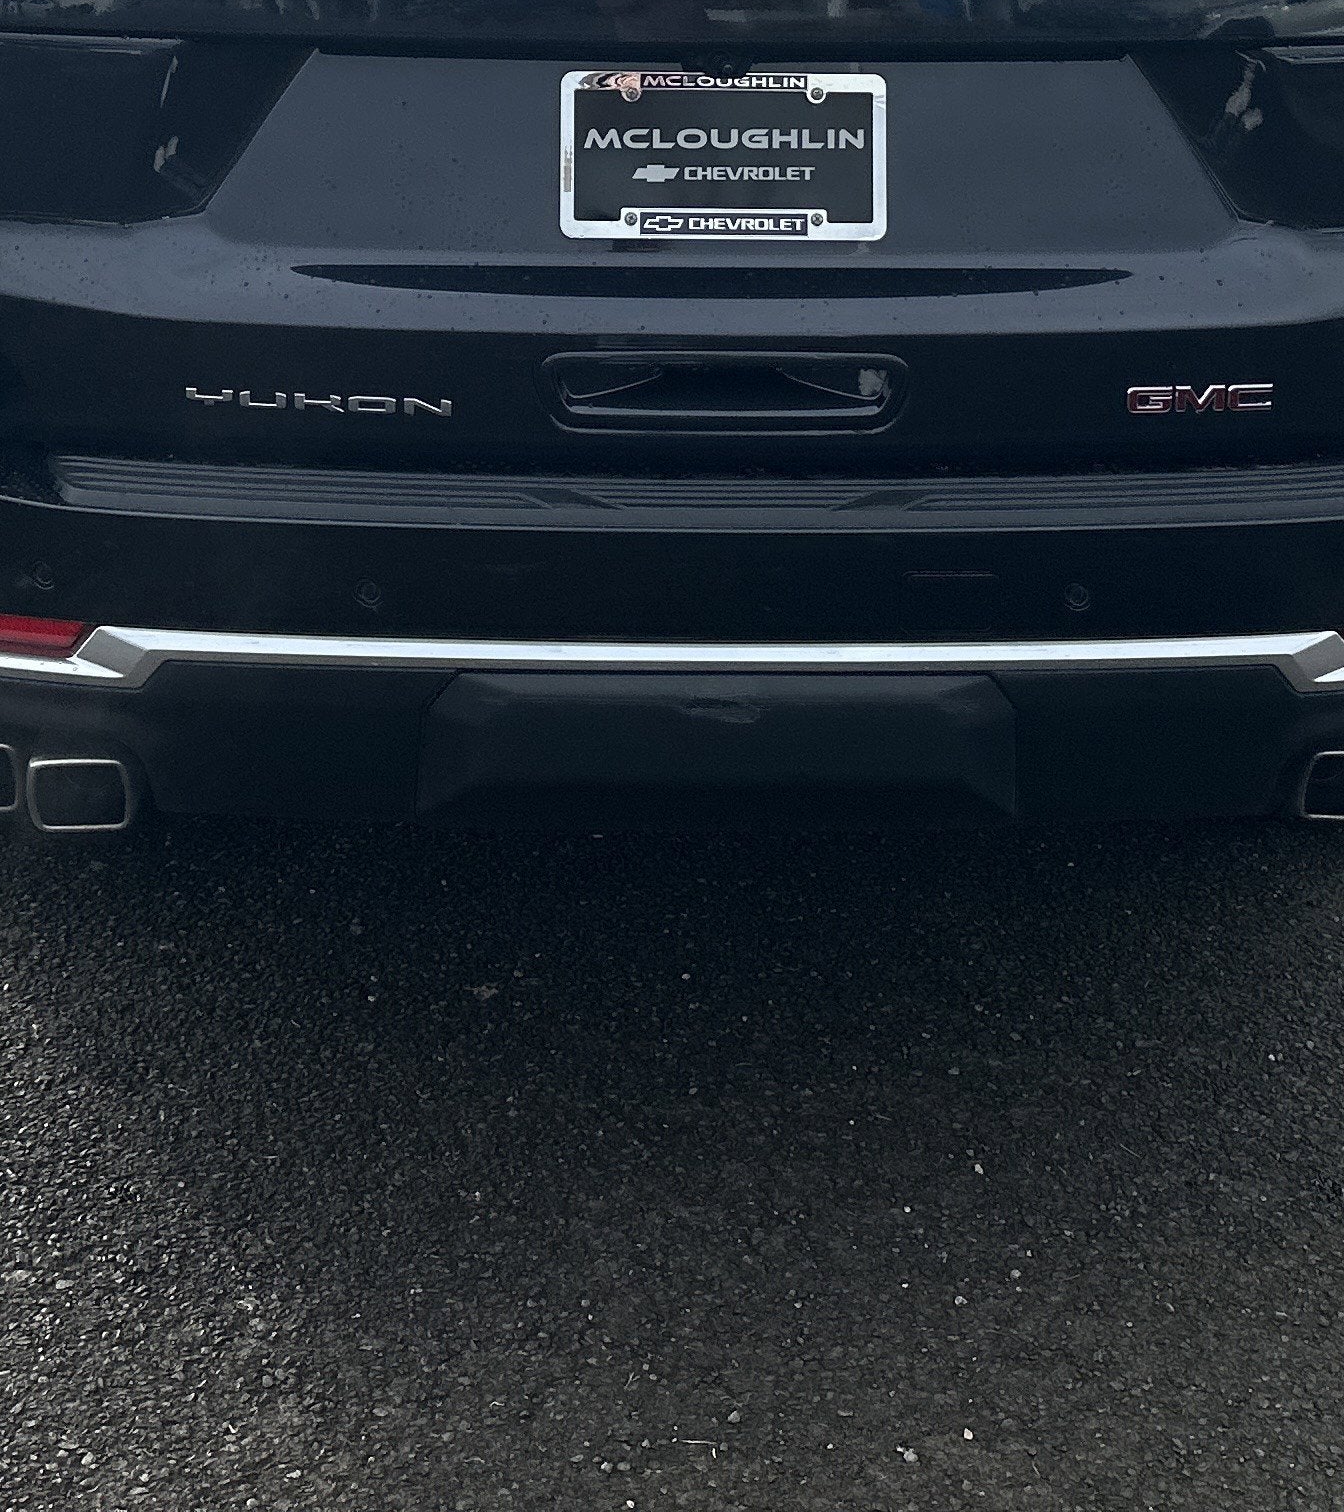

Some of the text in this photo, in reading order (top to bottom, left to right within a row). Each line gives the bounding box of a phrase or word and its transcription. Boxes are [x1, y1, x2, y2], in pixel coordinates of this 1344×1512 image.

[642, 74, 805, 89] MCLOUGHLIN
[584, 128, 866, 150] MCLOUGHLIN
[683, 166, 816, 181] CHEVROLET
[688, 216, 806, 232] CHEVROLET
[185, 386, 452, 417] YUKON
[1126, 382, 1274, 414] GMC
